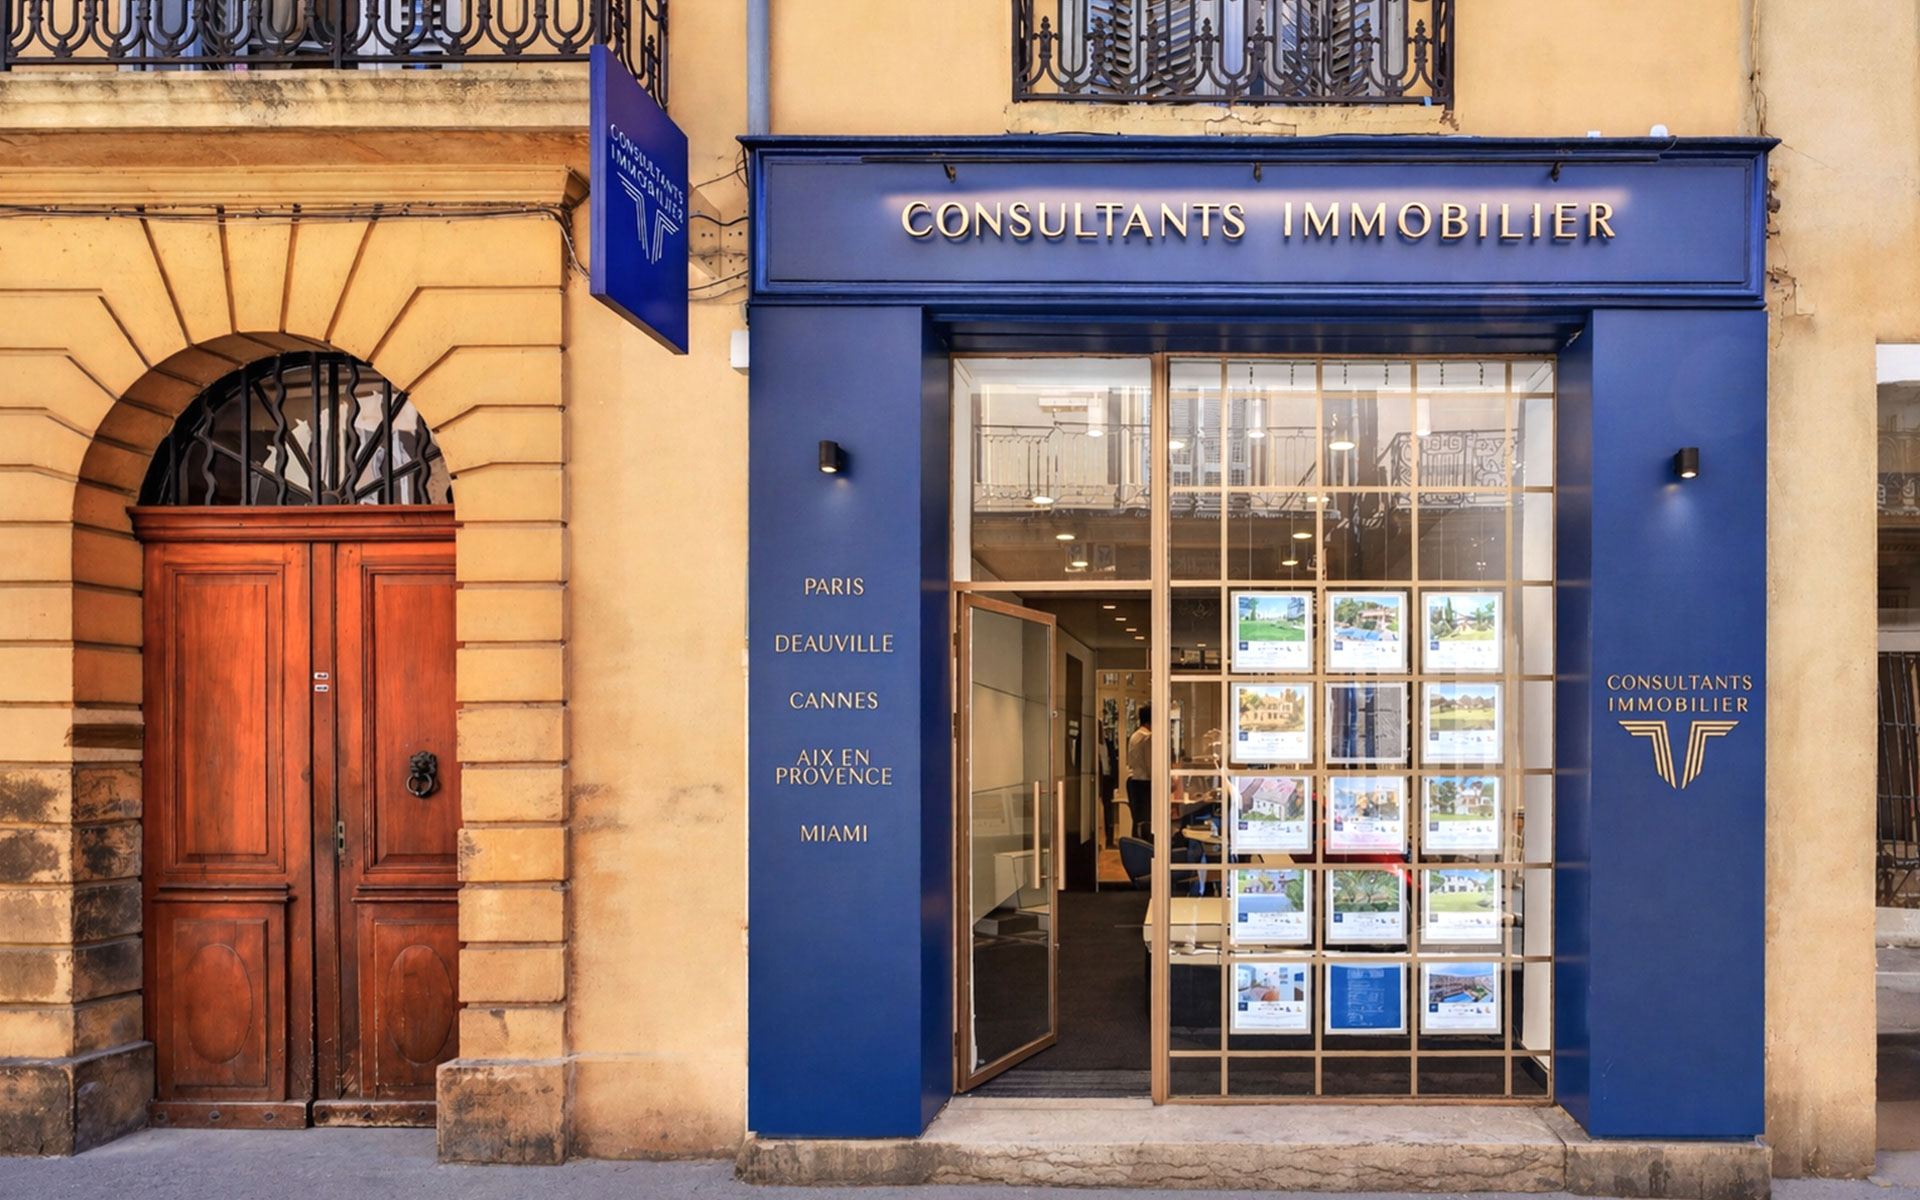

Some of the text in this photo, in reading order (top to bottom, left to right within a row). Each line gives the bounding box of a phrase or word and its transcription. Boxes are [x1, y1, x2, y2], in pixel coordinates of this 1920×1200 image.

[610, 123, 684, 206] CONSULTANTS
[611, 144, 684, 224] IMMOBILIER
[901, 201, 1618, 241] CONSULTANTS IMMOBILIER
[804, 577, 865, 596] PARIS
[775, 634, 894, 653] DEAUVILLE
[1606, 673, 1753, 691] CONSULTANTS
[789, 691, 879, 710] CANNES
[1608, 696, 1749, 713] IMMOBILIER
[797, 749, 870, 767] AIX EN
[775, 767, 893, 786] PROVENCE
[801, 824, 868, 843] MIAMI
